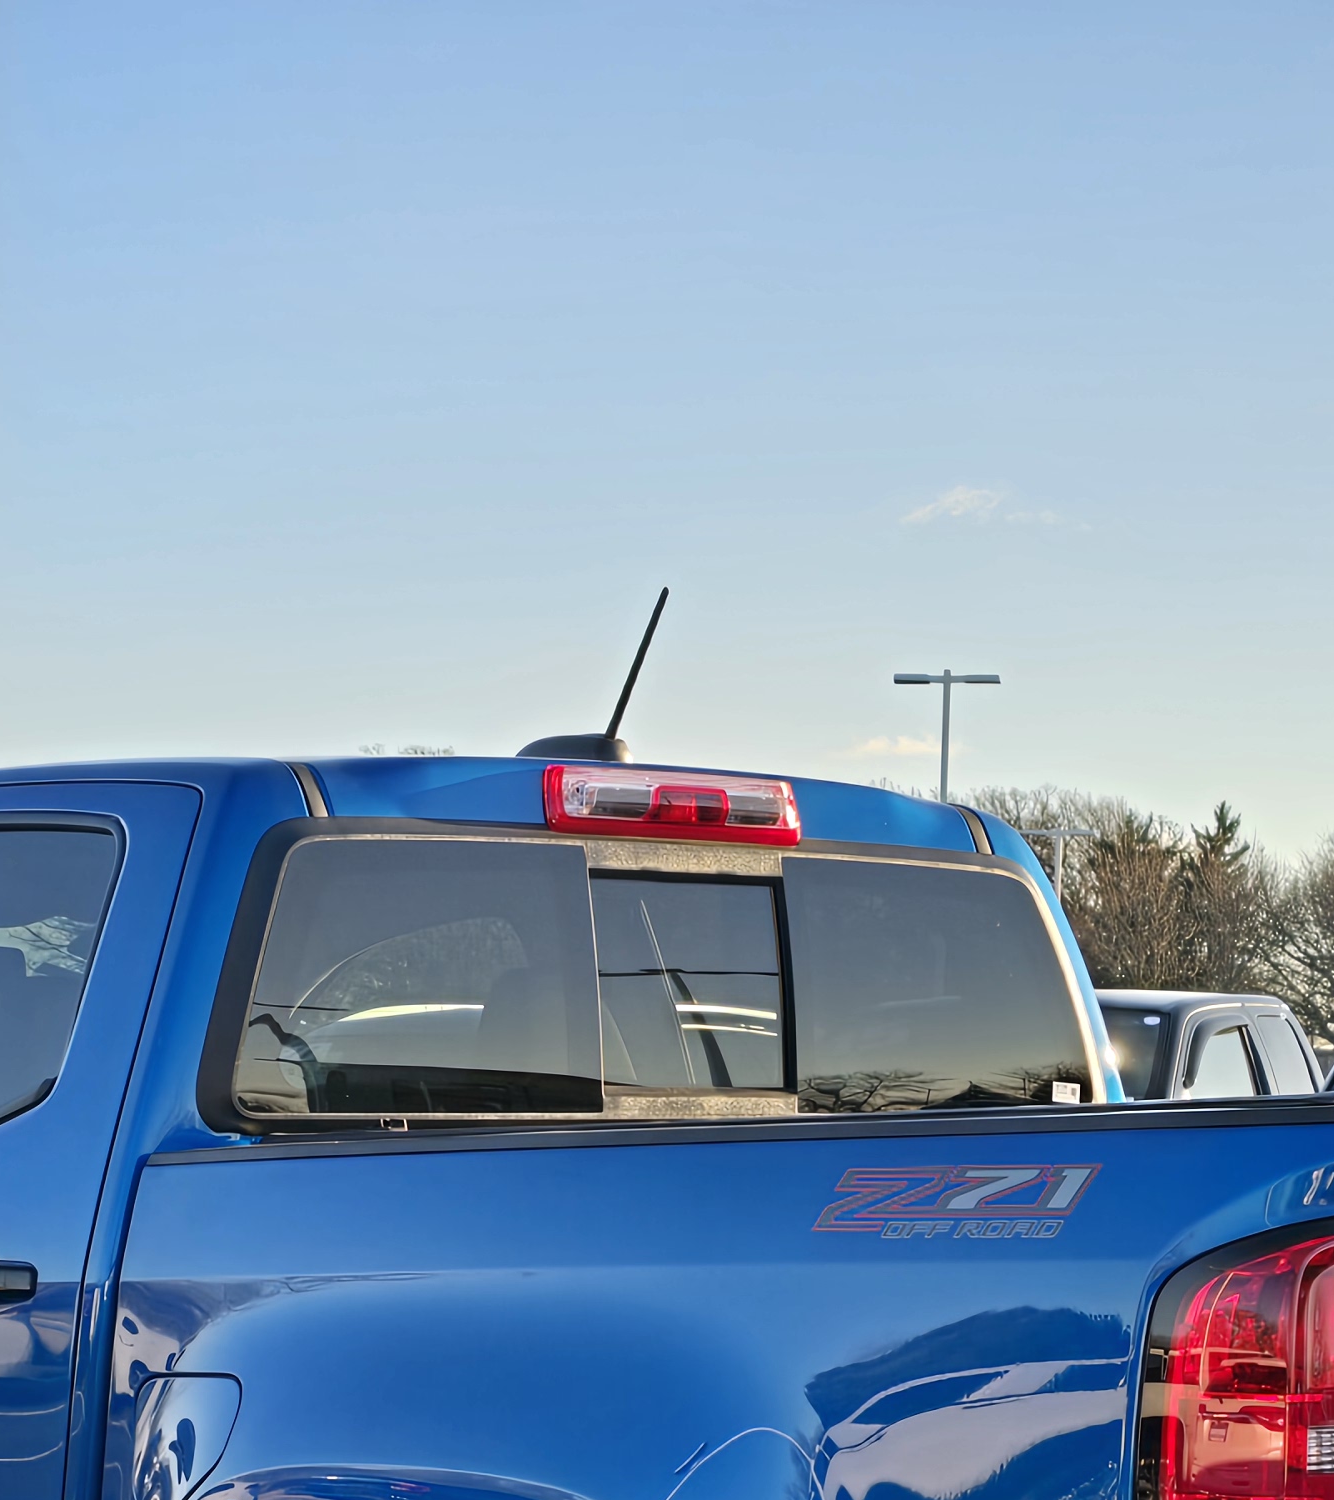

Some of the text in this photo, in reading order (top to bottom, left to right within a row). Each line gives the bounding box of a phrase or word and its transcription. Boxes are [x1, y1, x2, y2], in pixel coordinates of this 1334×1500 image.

[812, 1164, 1102, 1231] Z71
[880, 1220, 1065, 1239] OFF ROAD
